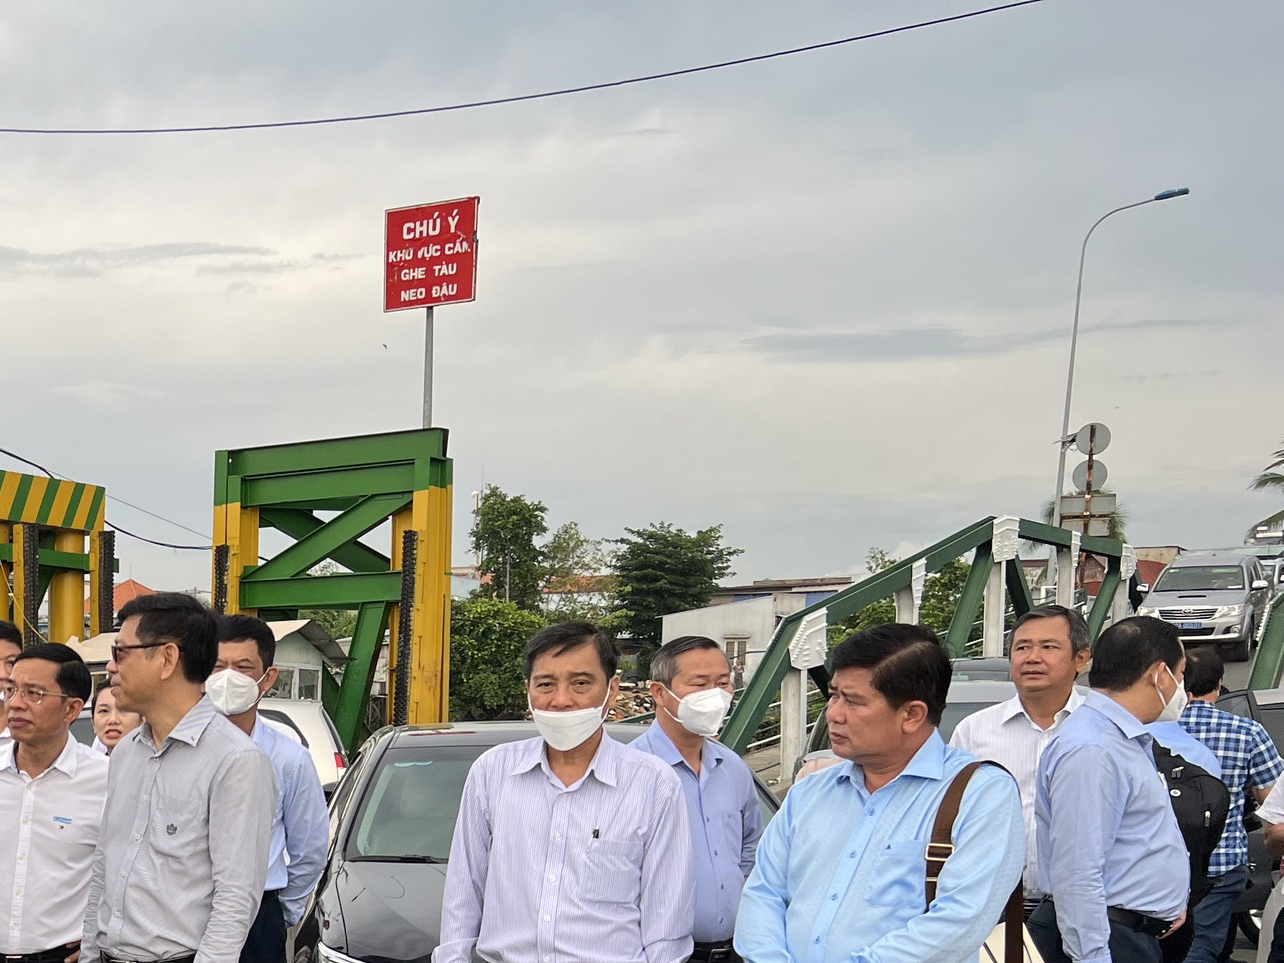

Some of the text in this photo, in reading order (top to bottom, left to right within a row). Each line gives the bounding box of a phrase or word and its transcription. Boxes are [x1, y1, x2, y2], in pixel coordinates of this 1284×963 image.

[402, 208, 460, 240] CHÚ Ý
[388, 248, 414, 263] KHU
[400, 260, 457, 281] GHE TÀU
[400, 287, 426, 302] NEO
